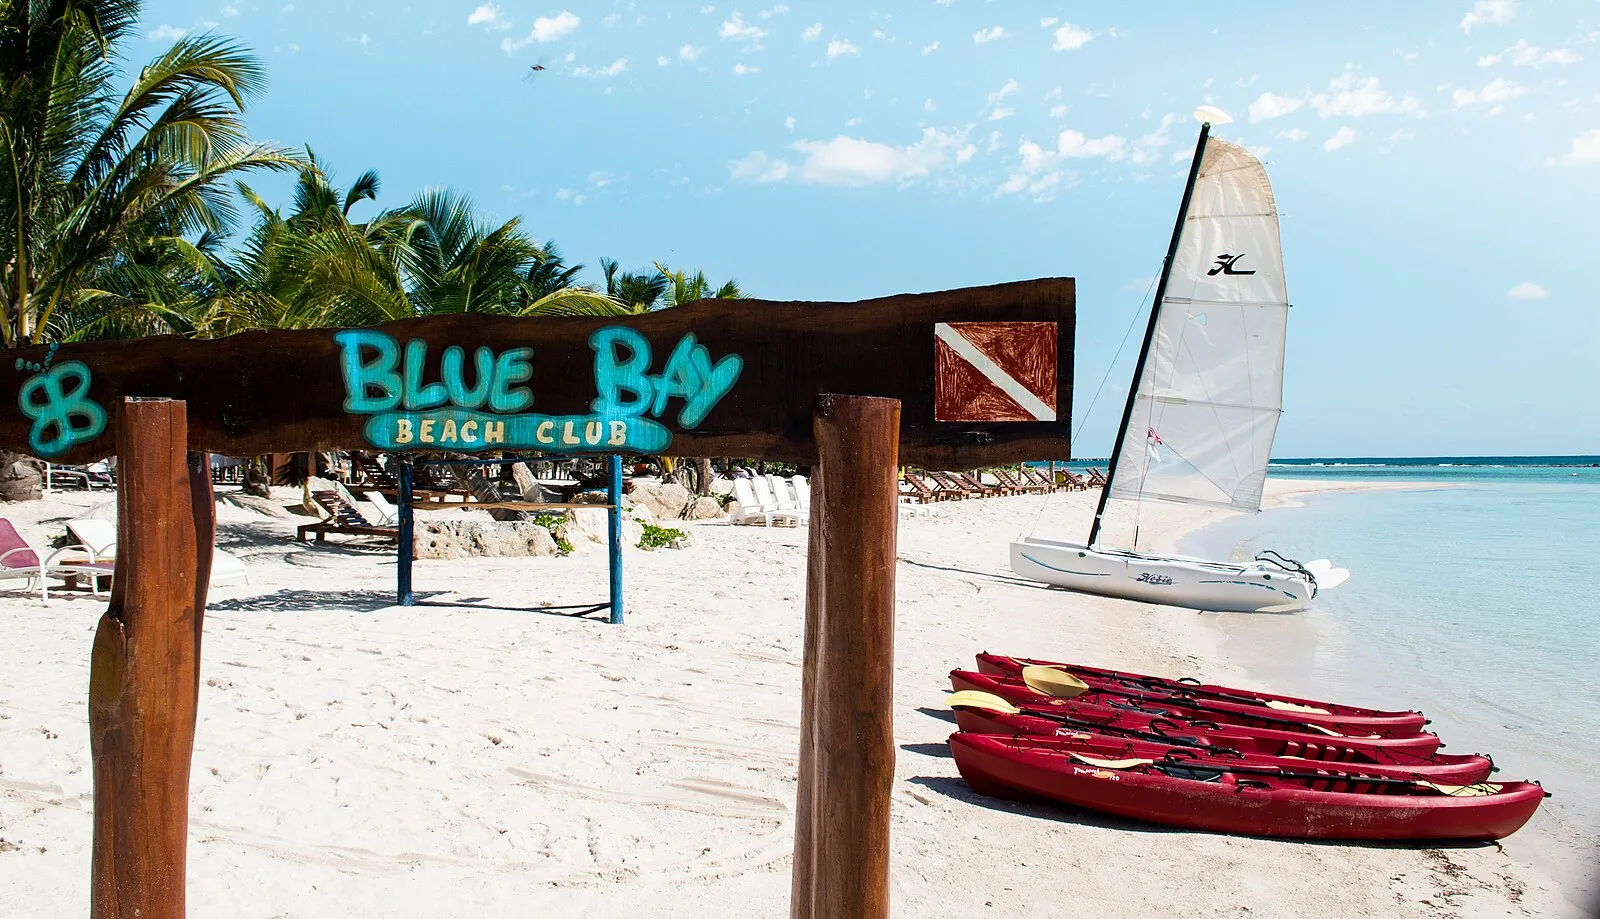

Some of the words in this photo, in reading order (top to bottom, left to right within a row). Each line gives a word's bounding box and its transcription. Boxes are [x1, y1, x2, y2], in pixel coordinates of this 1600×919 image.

[334, 329, 535, 414] BLUE
[588, 325, 744, 430] BAY
[395, 419, 505, 444] BEACH
[536, 419, 628, 445] CLUB
